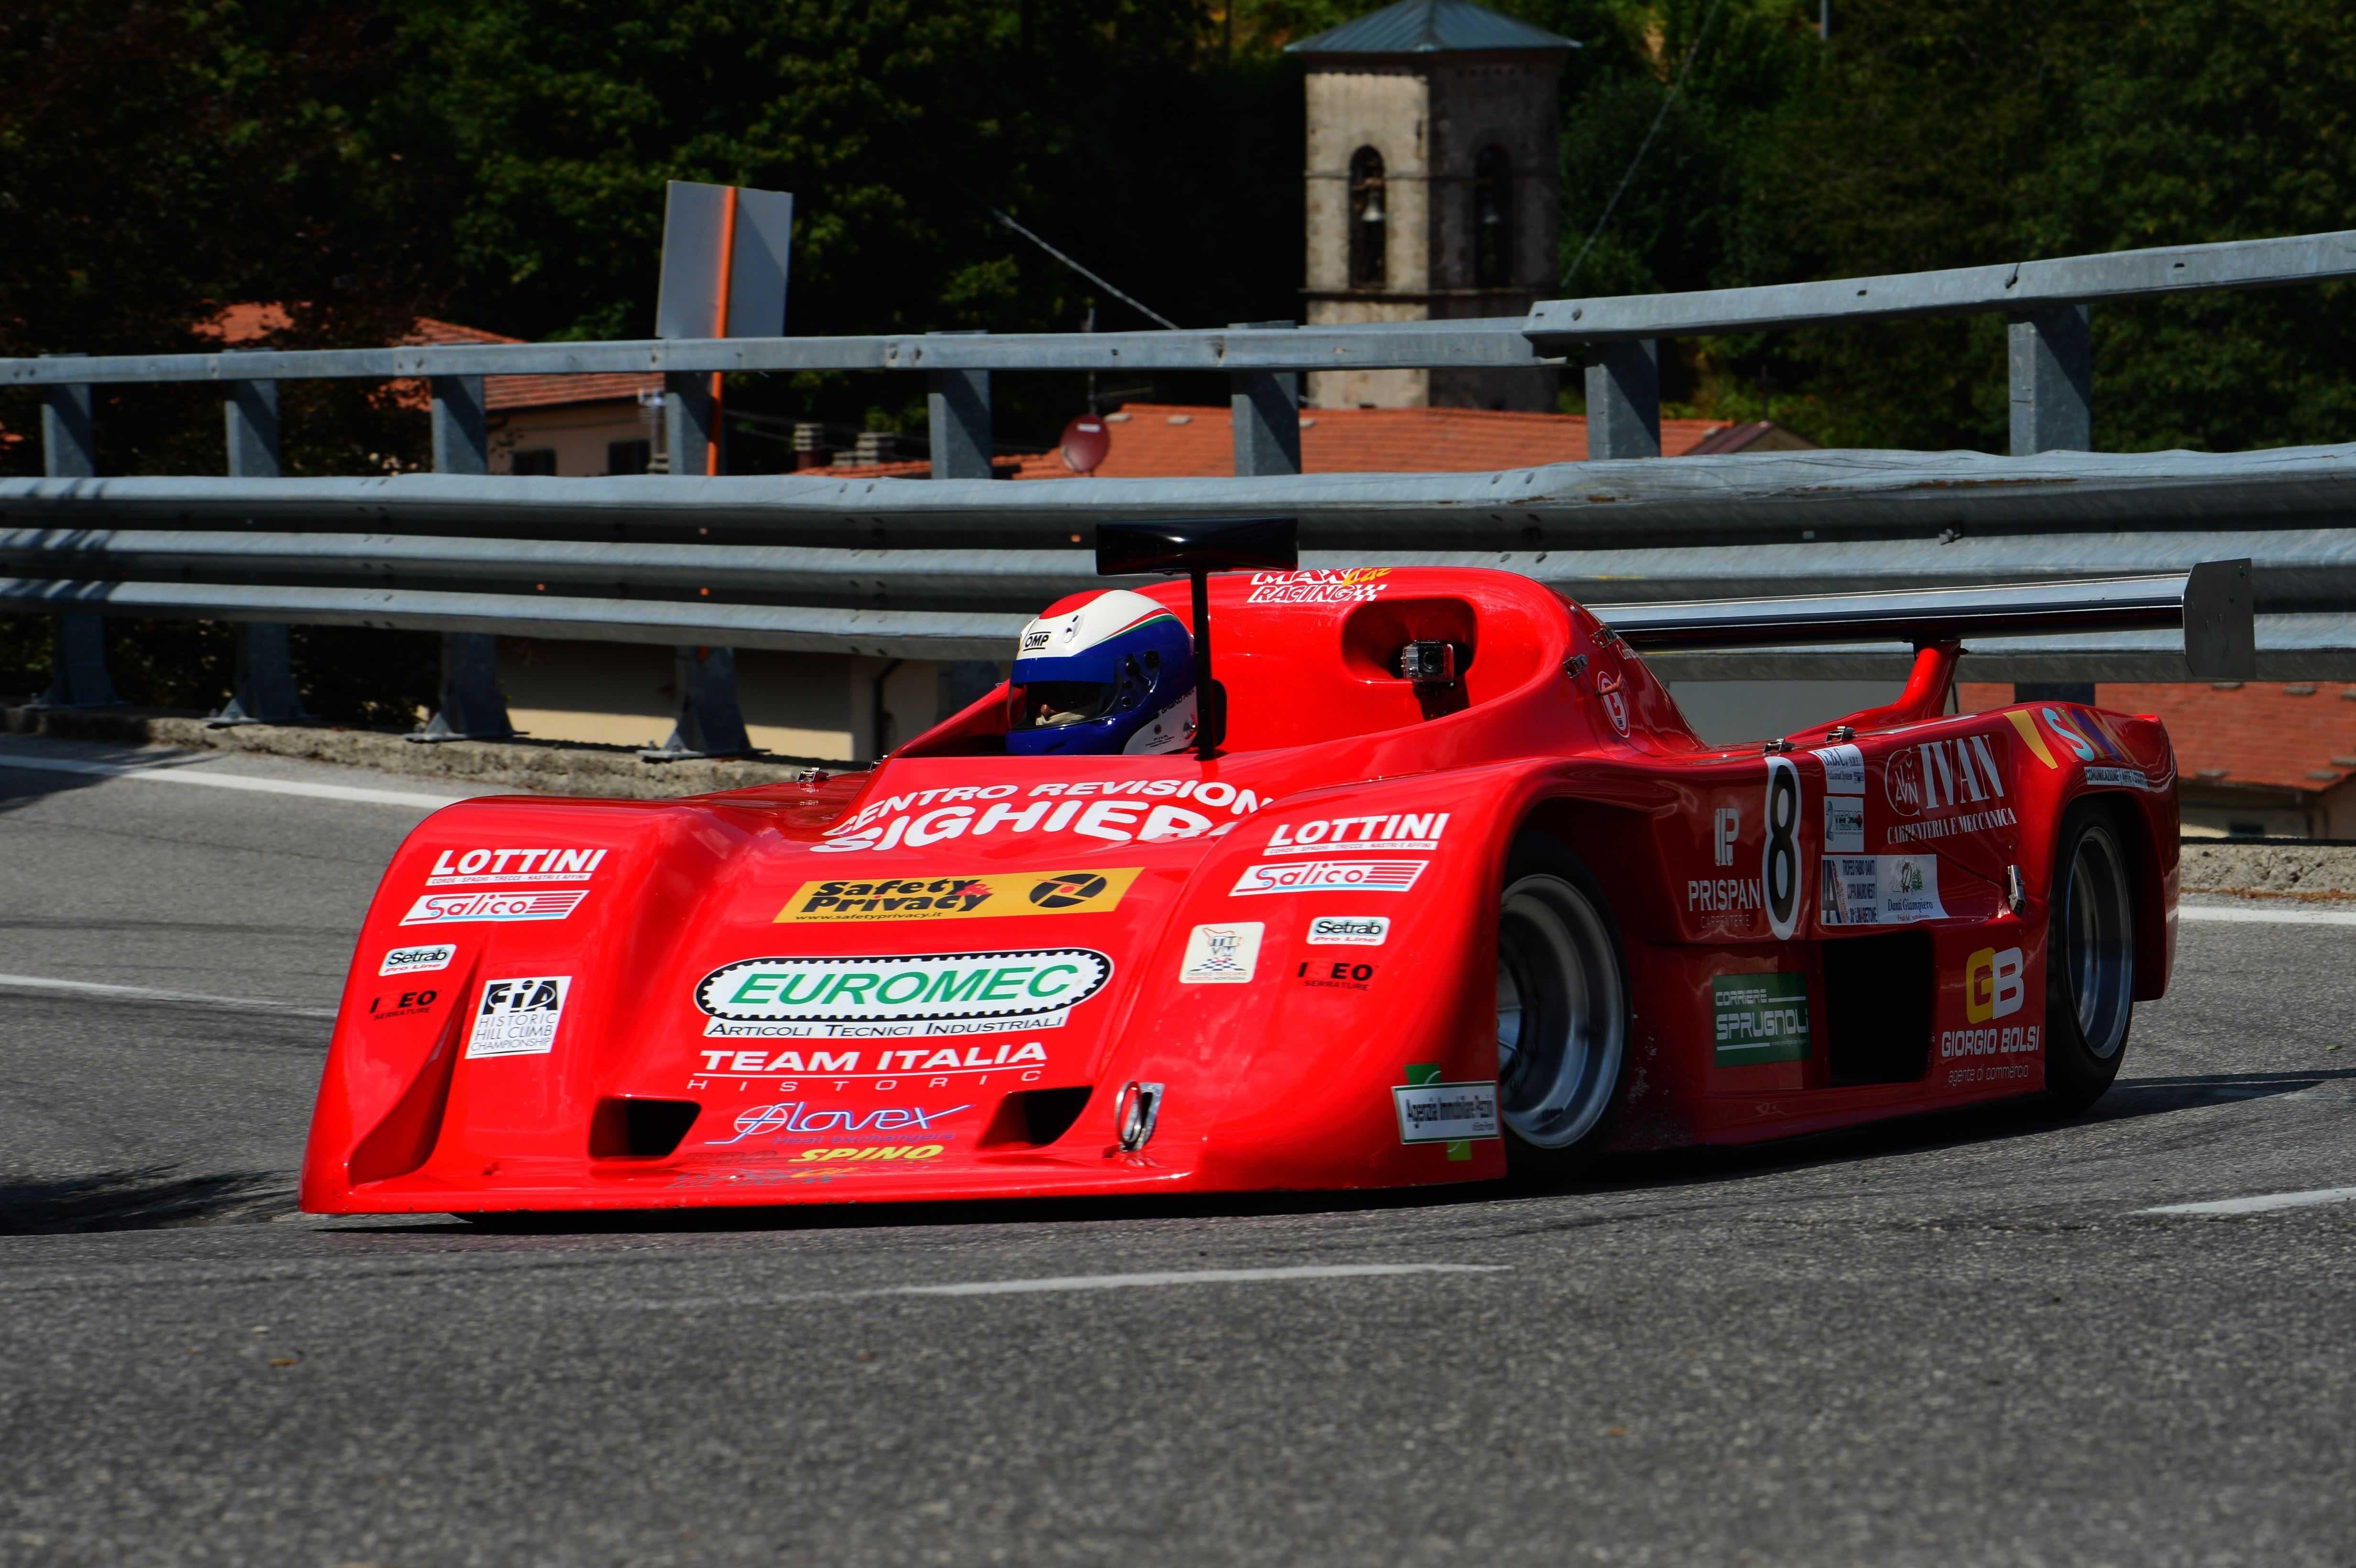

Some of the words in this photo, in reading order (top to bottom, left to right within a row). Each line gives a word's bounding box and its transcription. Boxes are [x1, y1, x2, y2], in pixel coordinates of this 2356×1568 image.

[1247, 585, 1354, 603] RACING
[1025, 635, 1049, 647] OMP
[1918, 735, 2004, 808] IVAN
[822, 784, 1018, 836] CENTRO
[1266, 813, 1451, 847] LOTTINI
[1887, 819, 1950, 844] CARPENTERIA
[1951, 817, 1957, 835] E
[1958, 807, 2017, 833] MECCANICA
[1765, 759, 1800, 932] 8
[430, 849, 608, 875] LOTTINI
[1256, 862, 1363, 891] Salico
[811, 878, 982, 896] Safety
[1688, 879, 1761, 911] PRISPAN
[425, 894, 527, 920] Salico
[801, 893, 994, 912] Privacy
[1903, 899, 1933, 913] Giampiero
[795, 912, 943, 921] www.safetyprivacy.it
[1316, 920, 1381, 935] Setrab
[389, 949, 447, 965] Setrab
[728, 964, 1078, 1005] EUROMEC
[1304, 980, 1370, 991] SERRATURE
[1966, 947, 2024, 1024] GB
[1716, 989, 1767, 1006] CORRIERE
[374, 1007, 432, 1020] SERRATURE
[479, 1013, 557, 1028] HISTORIC
[475, 1028, 501, 1041] HILL
[508, 1025, 553, 1038] CLIMB
[708, 1023, 811, 1037] ARTICOLI
[826, 1024, 914, 1037] TECNICI
[925, 1016, 1064, 1035] INDUSTRIALI
[471, 1037, 552, 1051] CHAMPIONSHIP
[1942, 1029, 1997, 1057] GIORGIO
[2000, 1026, 2040, 1053] BOLSI
[700, 1050, 861, 1071] TEAM
[876, 1042, 1048, 1071] ITALIA
[686, 1070, 1042, 1092] HISTORIC
[1949, 1068, 1974, 1086] agente
[1977, 1065, 1985, 1081] di
[1986, 1064, 2029, 1080] commercio
[772, 1135, 823, 1146] Heat
[829, 1132, 955, 1145] exchangers
[789, 1144, 945, 1162] SPINO
